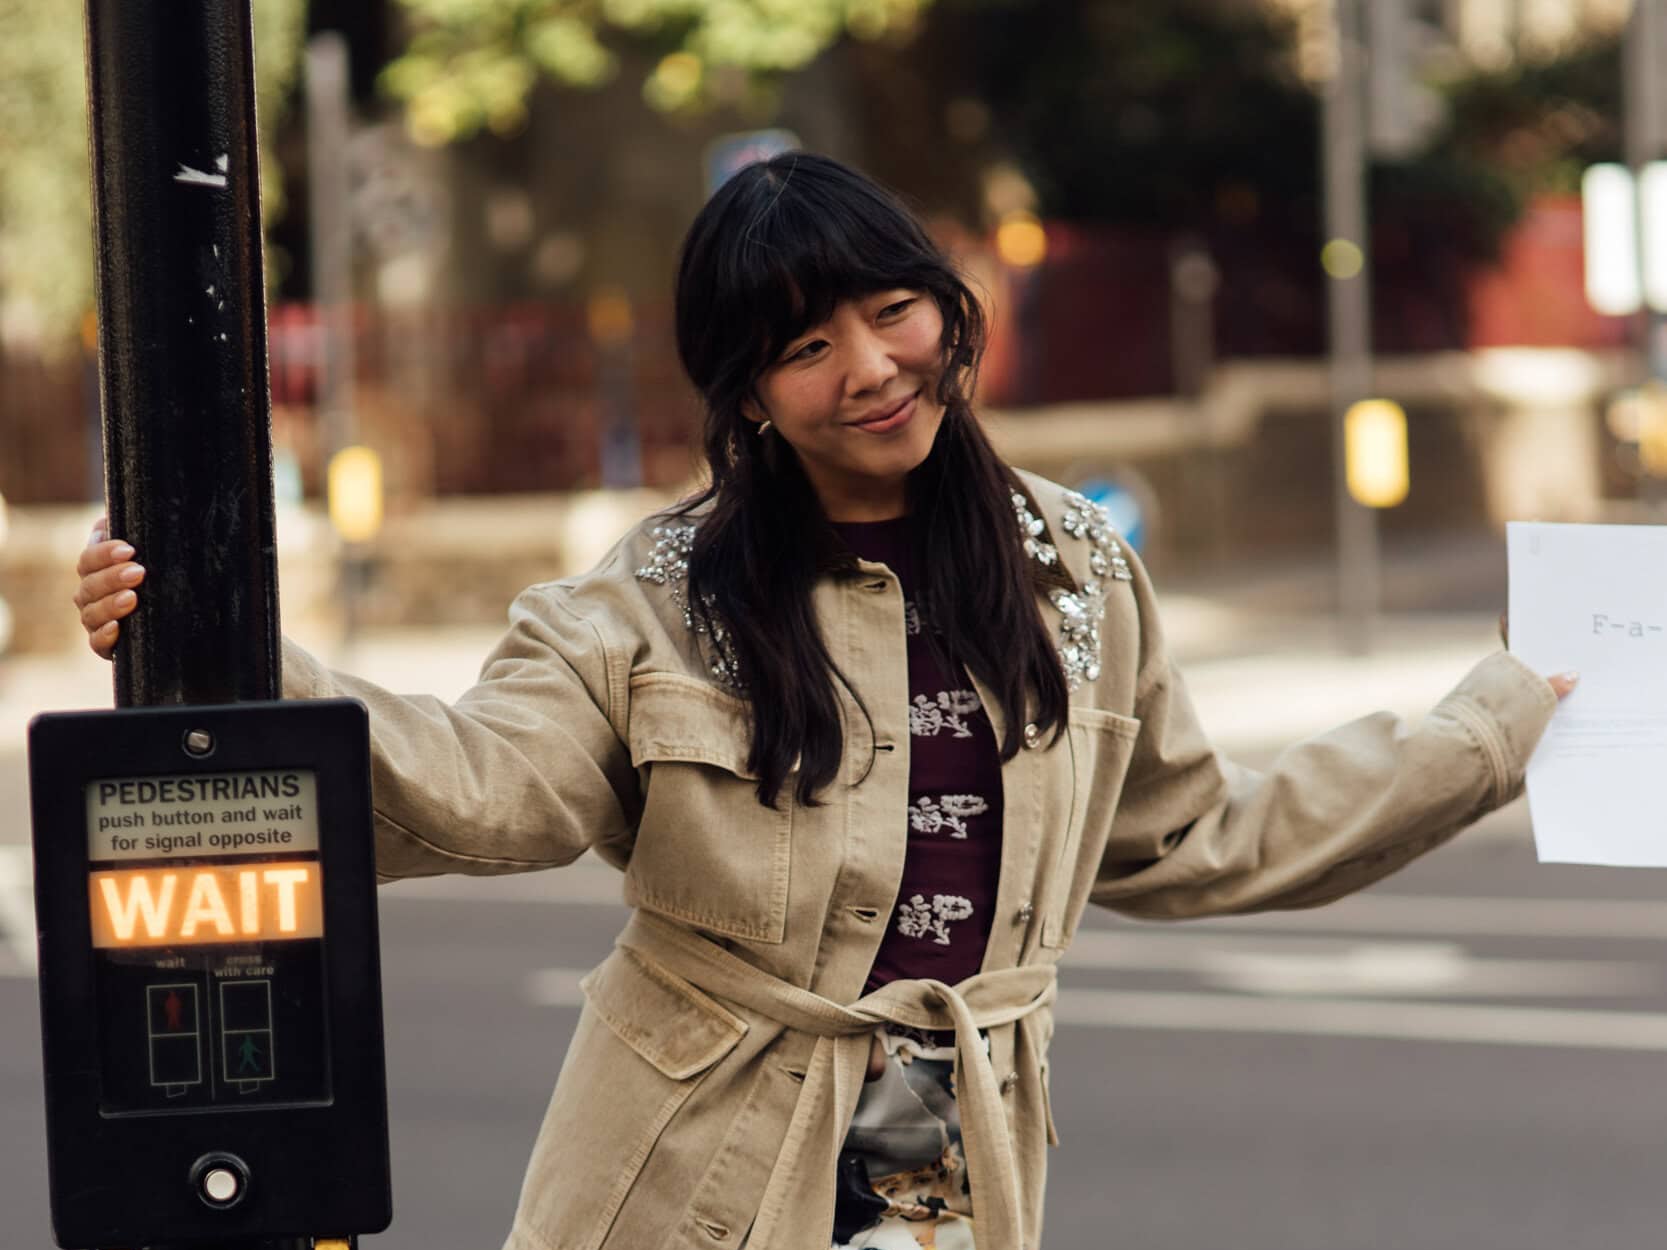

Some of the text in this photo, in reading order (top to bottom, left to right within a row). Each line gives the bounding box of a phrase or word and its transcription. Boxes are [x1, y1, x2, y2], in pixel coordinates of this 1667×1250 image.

[99, 775, 300, 806] PEDESTRIANS
[99, 805, 303, 832] push button and wait
[111, 829, 293, 853] for signal opposite
[100, 870, 308, 940] WAIT
[156, 957, 186, 968] wait
[215, 965, 274, 976] with care
